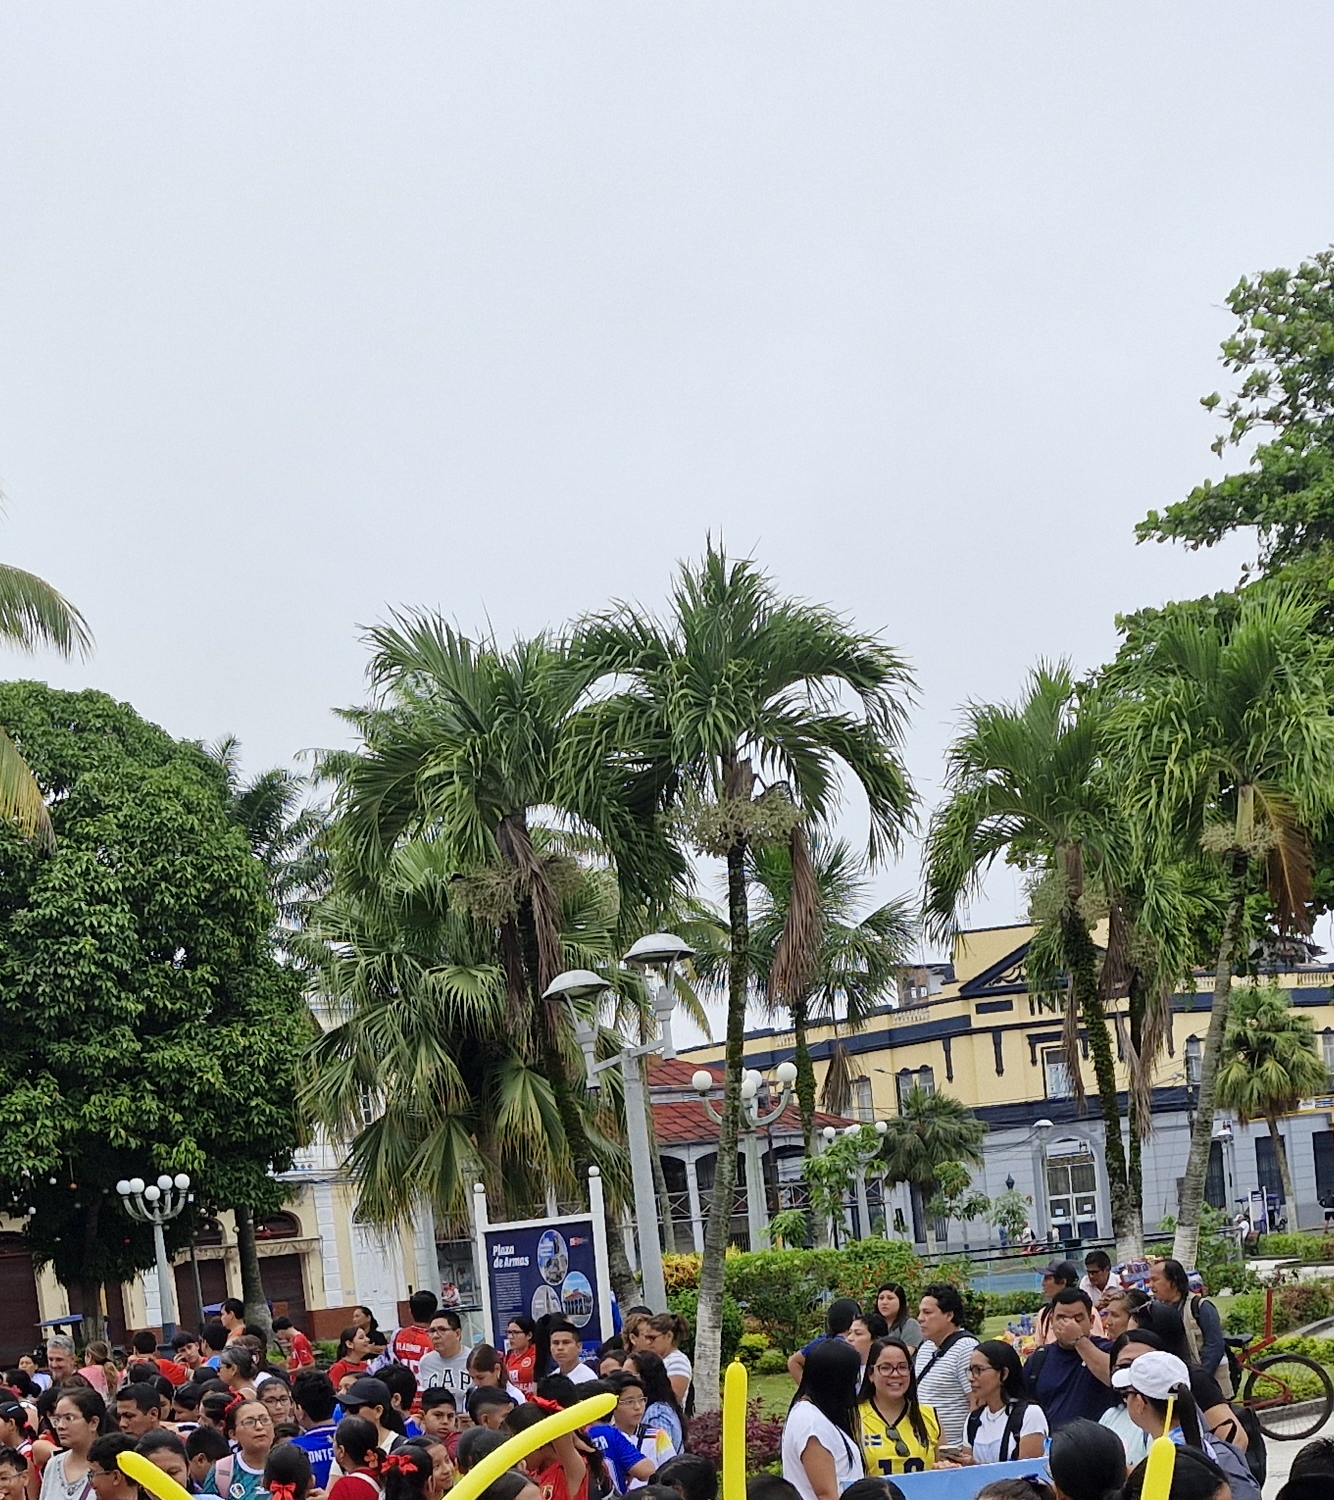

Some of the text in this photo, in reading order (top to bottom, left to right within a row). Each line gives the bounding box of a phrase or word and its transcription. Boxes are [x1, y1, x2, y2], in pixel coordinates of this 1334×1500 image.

[493, 1244, 515, 1257] Plaza
[494, 1256, 530, 1268] de Armas
